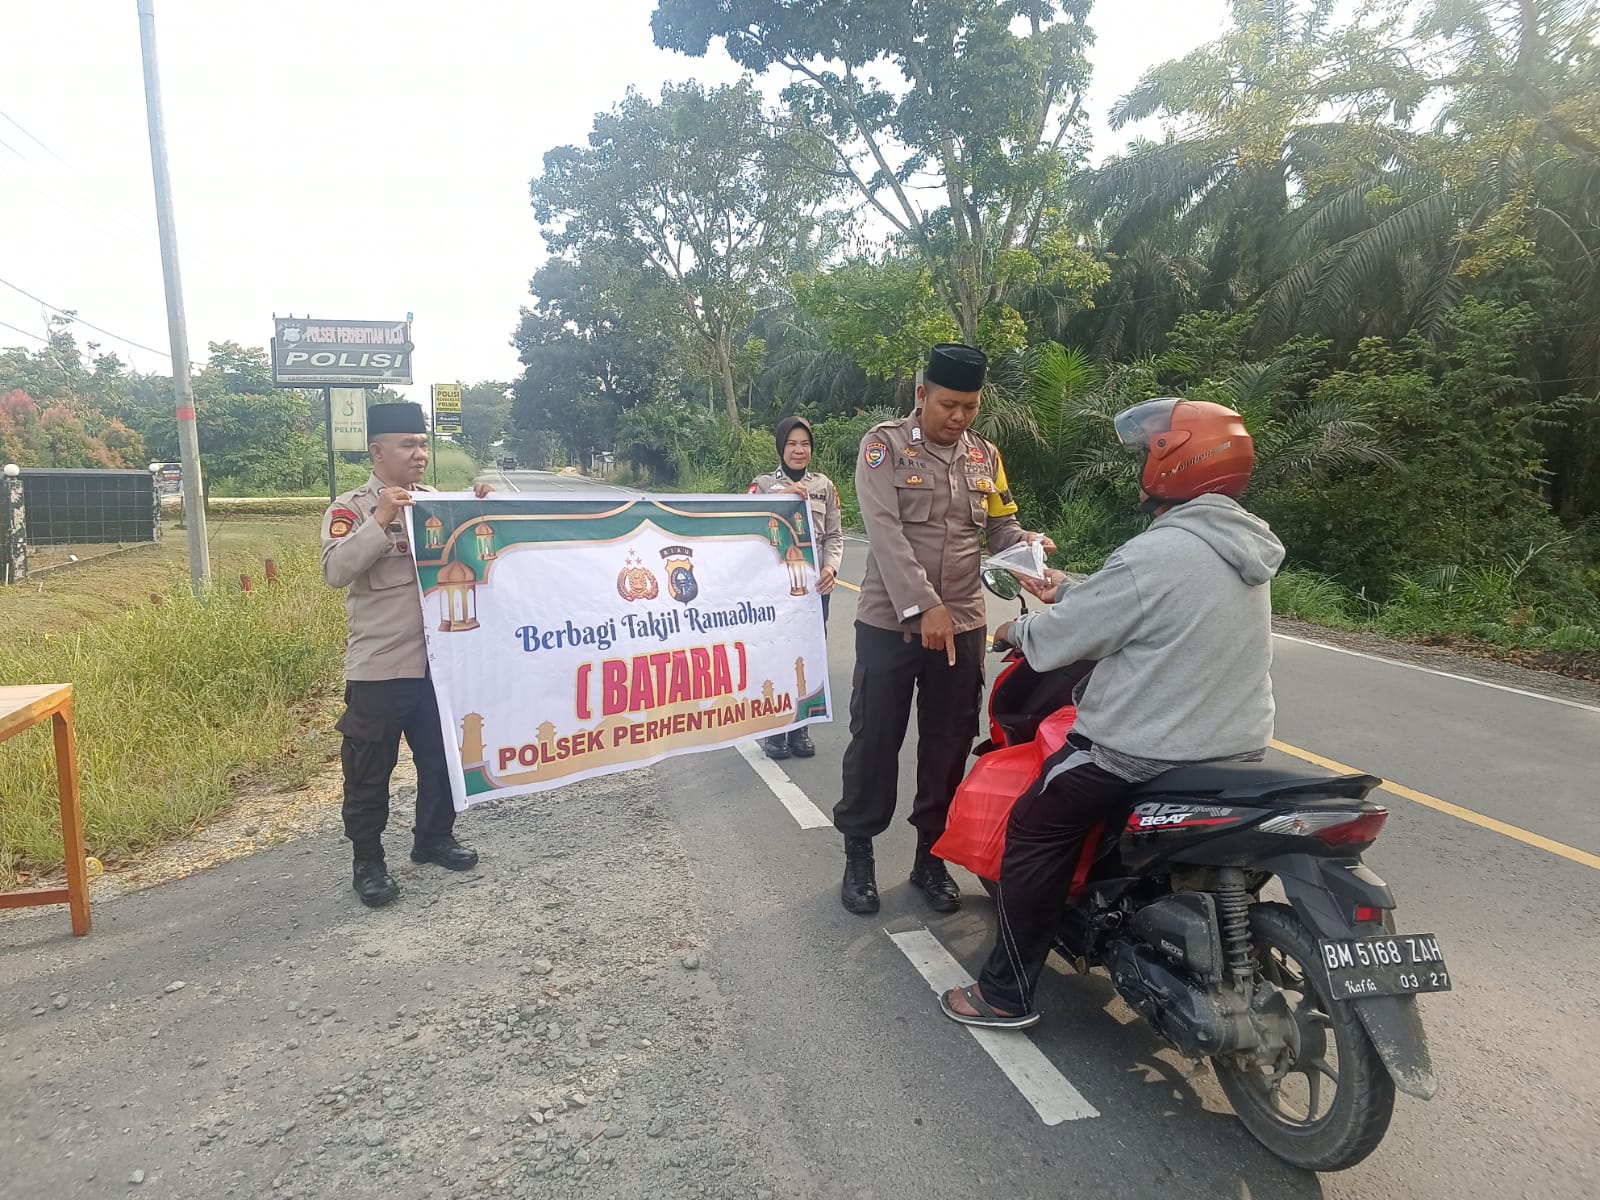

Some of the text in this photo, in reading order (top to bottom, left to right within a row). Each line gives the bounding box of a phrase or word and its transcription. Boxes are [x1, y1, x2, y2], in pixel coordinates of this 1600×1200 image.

[285, 352, 403, 368] POLISI
[515, 601, 776, 652] Berbagi Takjil Ramadhan
[499, 692, 793, 770] POLSEK PERHENTIAN RAJA
[1324, 938, 1443, 969] BM 5168 ZAH
[1400, 973, 1419, 989] 03
[1430, 972, 1448, 987] 27
